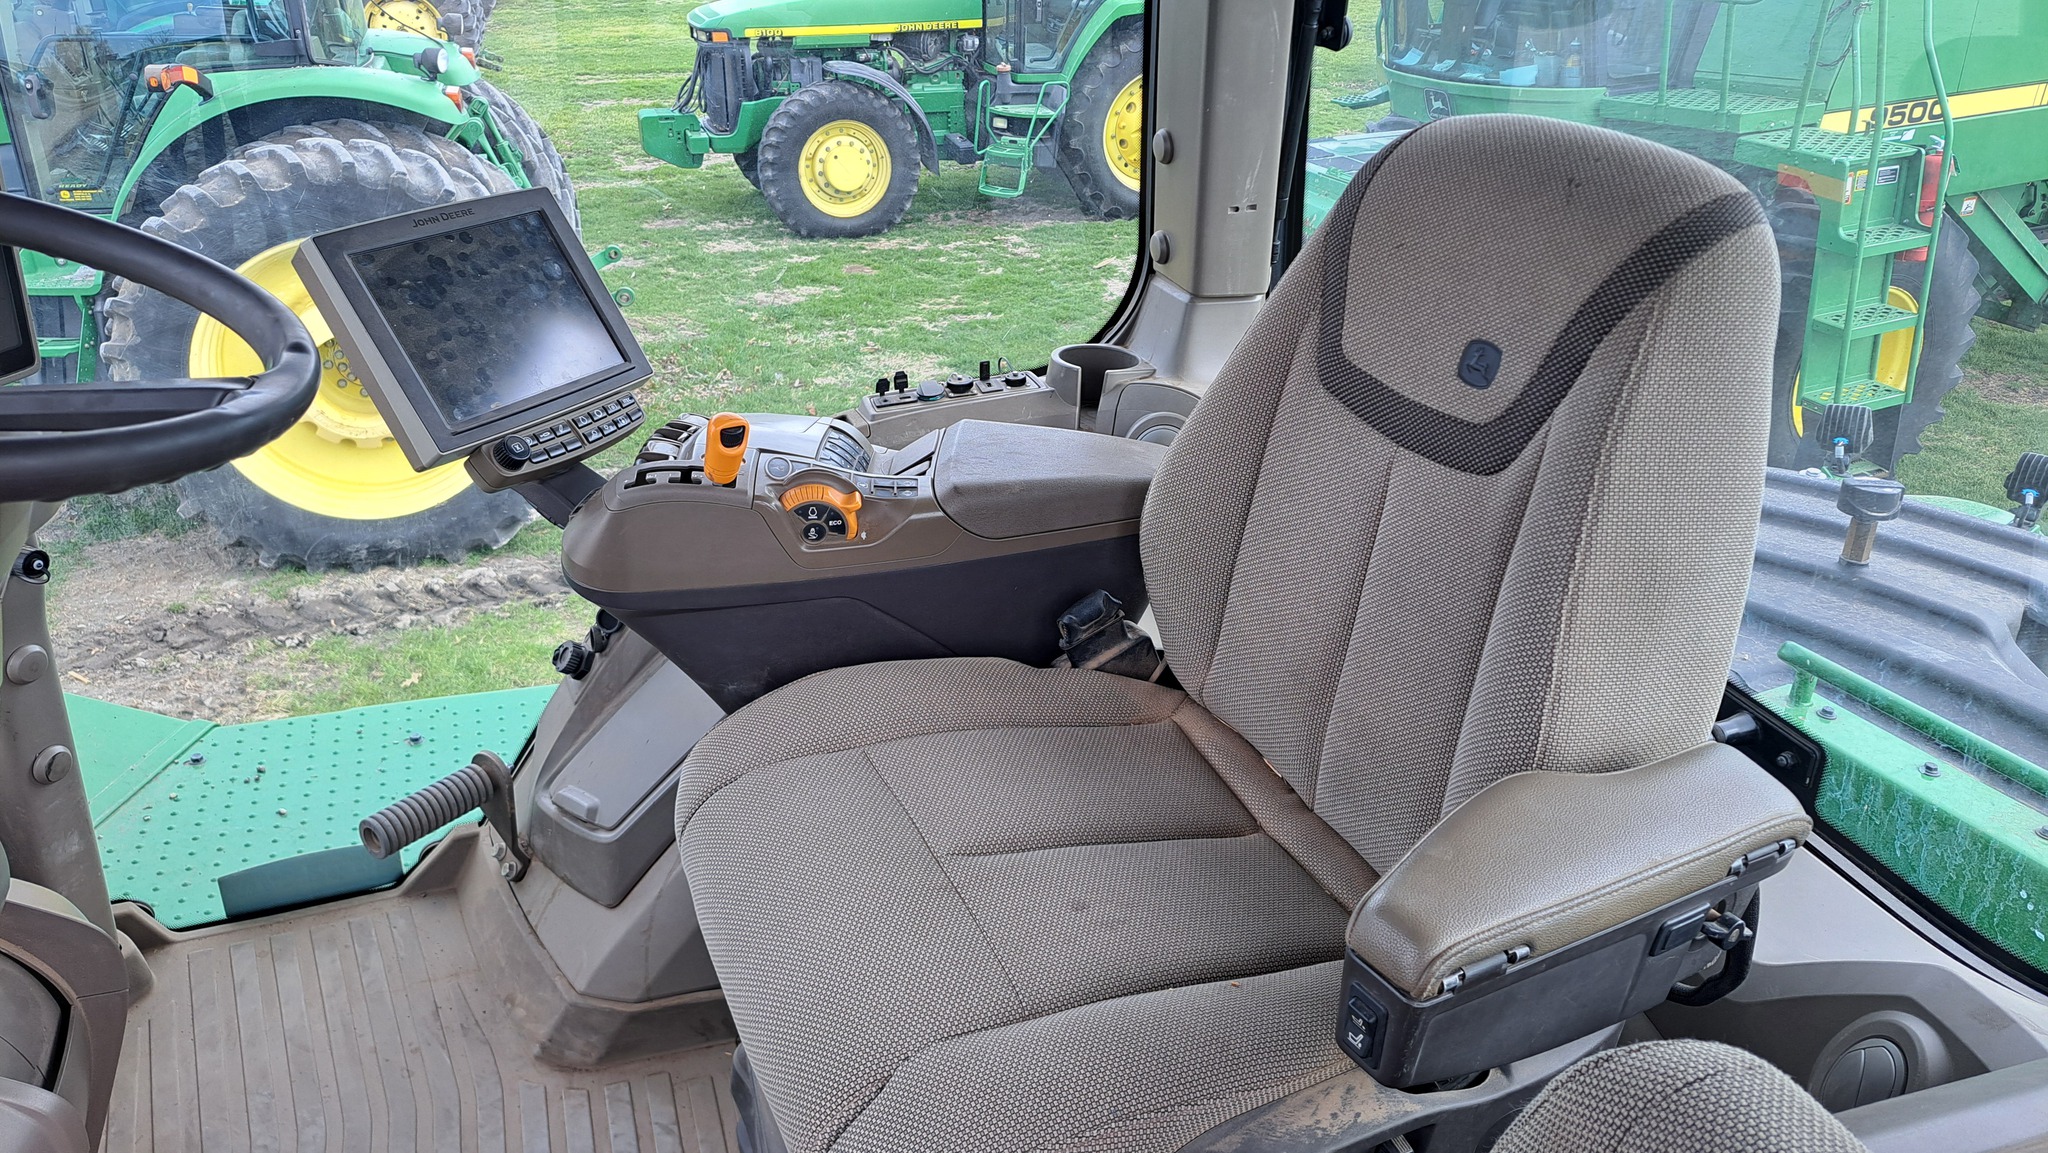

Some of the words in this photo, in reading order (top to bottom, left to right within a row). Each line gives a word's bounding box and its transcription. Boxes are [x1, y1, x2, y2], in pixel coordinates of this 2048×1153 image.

[895, 23, 924, 32] JOHN
[924, 21, 958, 31] DEERE
[755, 29, 783, 37] 8100
[412, 215, 440, 228] JOHN
[440, 208, 475, 221] DEERE
